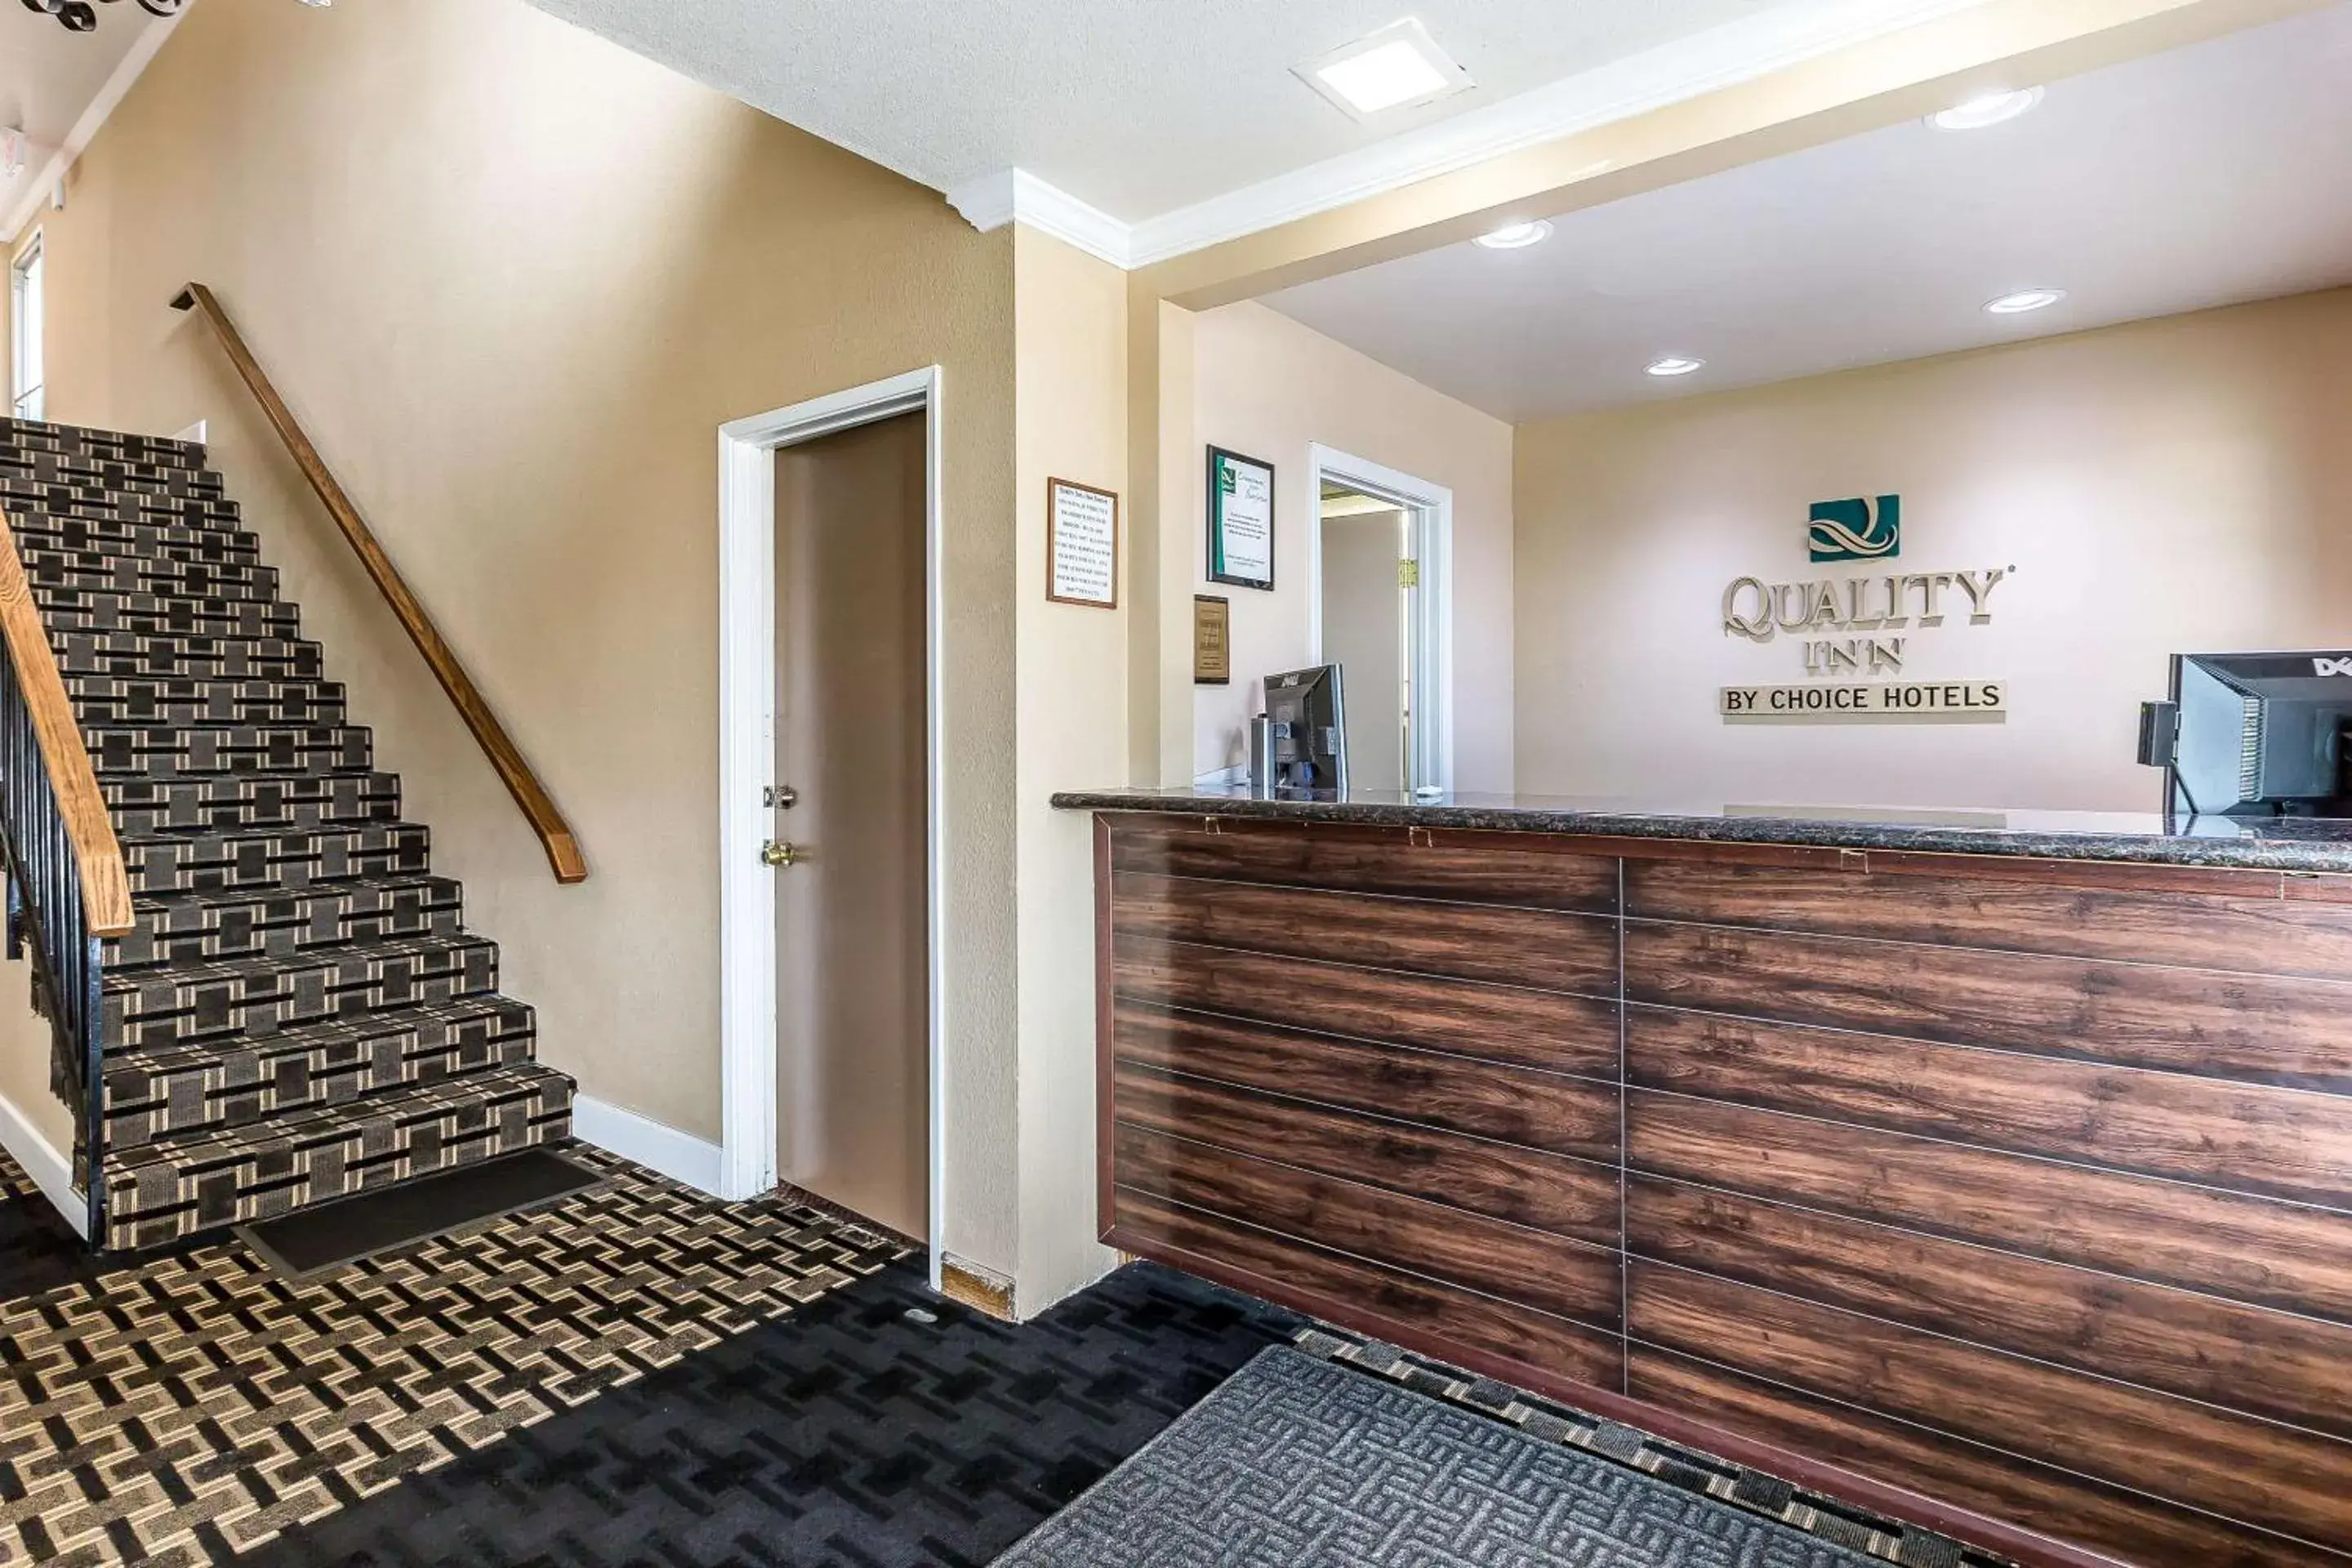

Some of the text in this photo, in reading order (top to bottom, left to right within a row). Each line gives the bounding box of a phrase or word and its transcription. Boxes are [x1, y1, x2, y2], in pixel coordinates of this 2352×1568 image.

[1722, 568, 2005, 638] QUALITY
[1805, 638, 1907, 669] INN
[1726, 685, 2000, 710] BY CHOICE HOTELS
